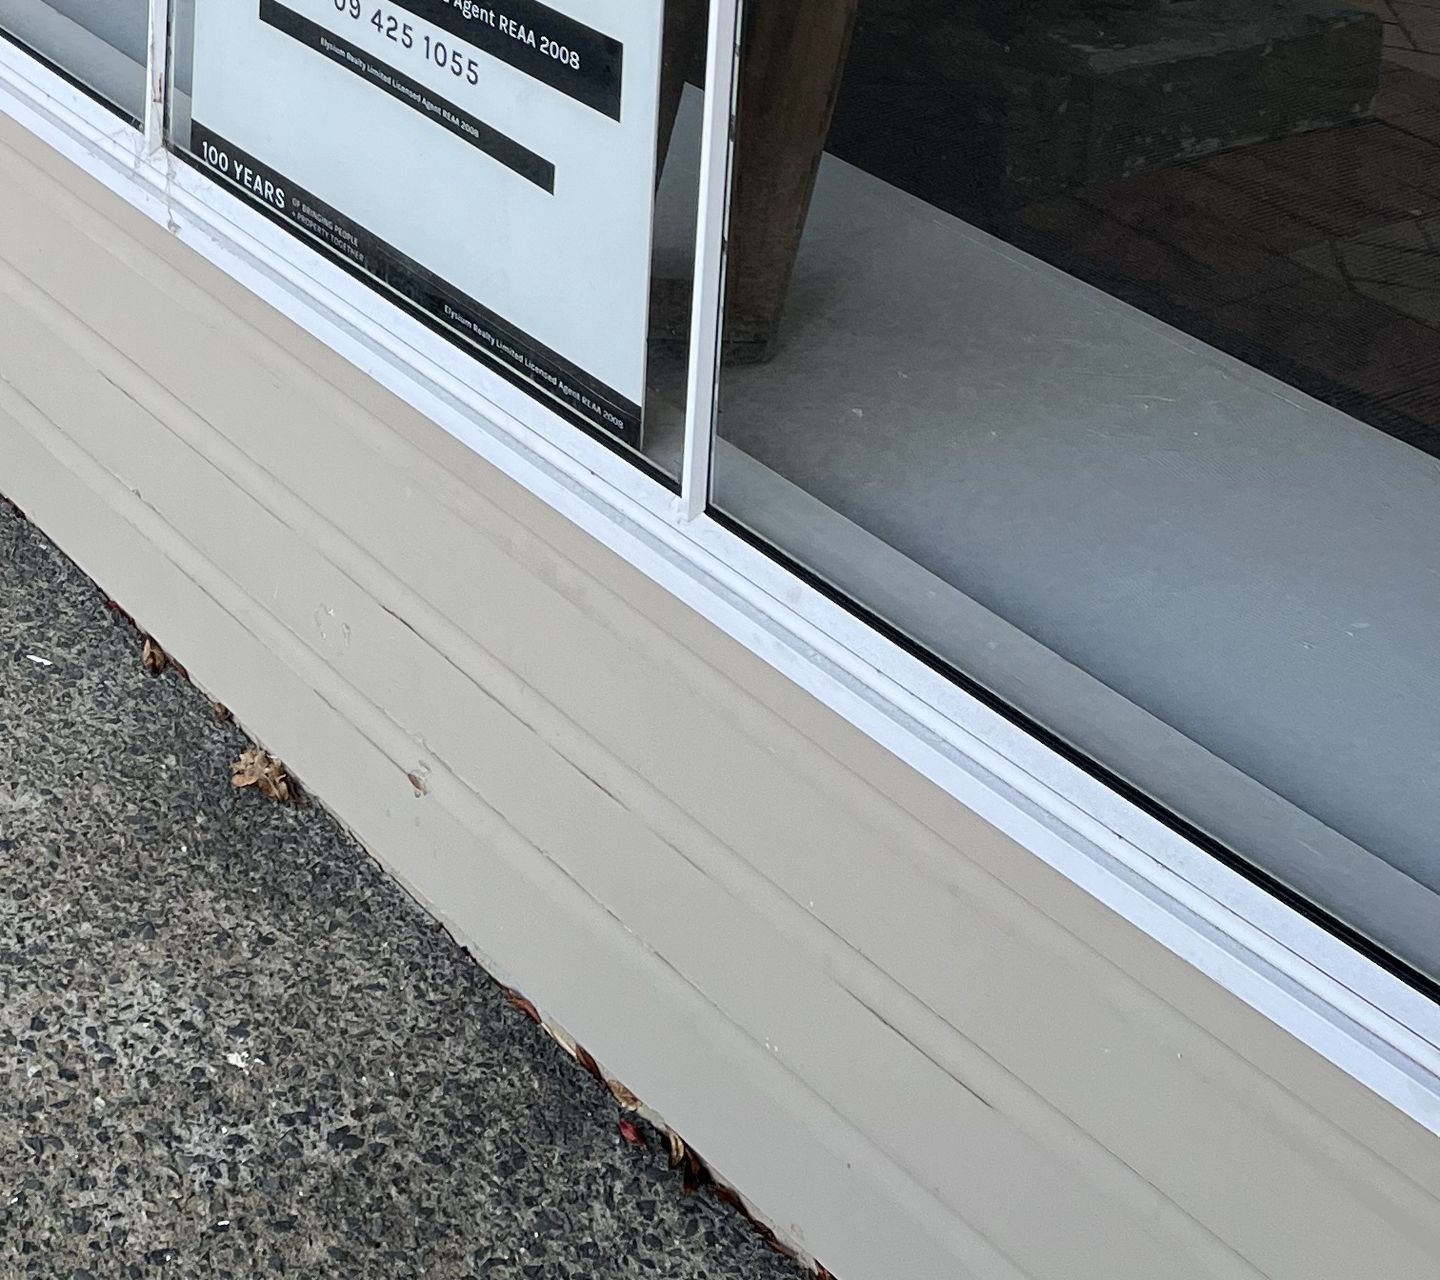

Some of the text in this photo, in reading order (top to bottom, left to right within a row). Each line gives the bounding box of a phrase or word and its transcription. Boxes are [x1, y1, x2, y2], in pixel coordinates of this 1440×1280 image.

[370, 8, 414, 49] 425
[424, 35, 479, 86] 1055
[499, 14, 536, 49] REAA
[539, 36, 581, 70] 2008
[320, 36, 480, 138] Elysium Realty Limited Licensed Agent REAA 2008
[202, 141, 286, 209] 100 YEARS
[291, 197, 359, 247] OF BRINGING PEOPLE
[296, 212, 330, 239] PROPERTY
[330, 233, 365, 261] TOGETHER
[444, 304, 625, 430] Elysium Realty Limited Licensed Agent REAA 2008
